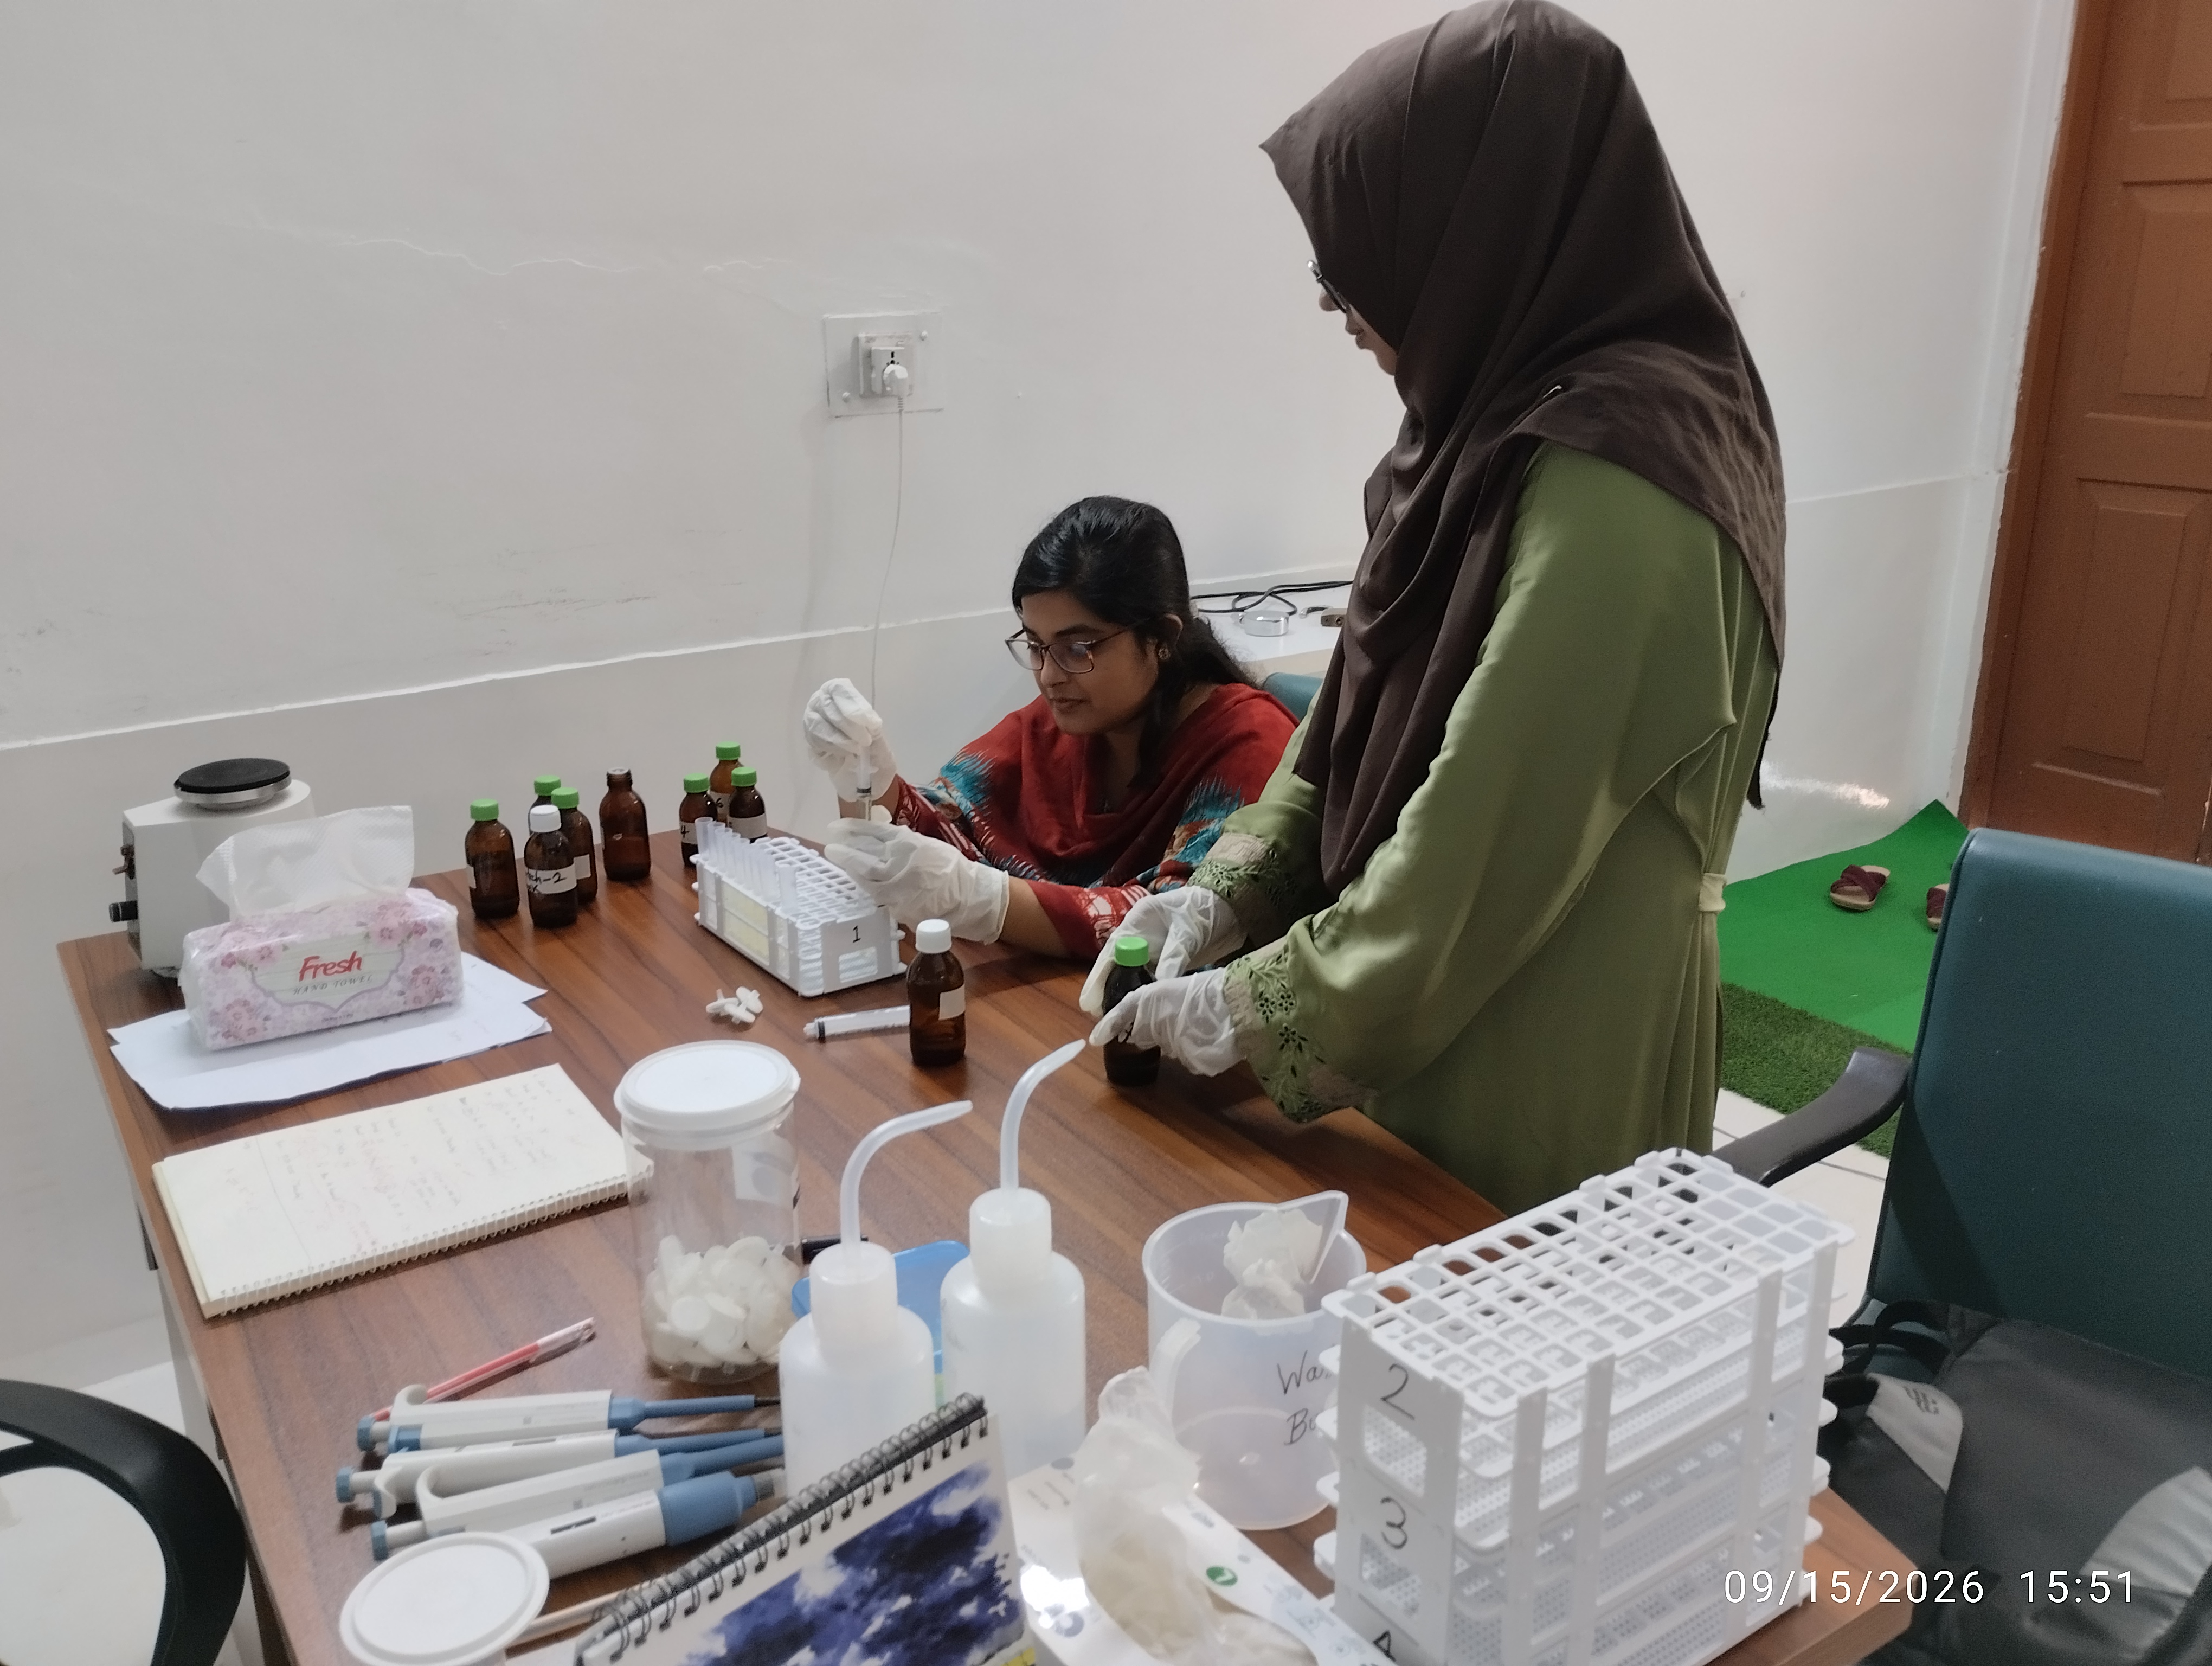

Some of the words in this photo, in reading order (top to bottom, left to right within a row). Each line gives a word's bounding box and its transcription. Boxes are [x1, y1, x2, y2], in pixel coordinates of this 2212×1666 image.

[716, 798, 724, 808] 6
[680, 825, 690, 838] 4
[852, 925, 861, 944] 1
[299, 950, 363, 982] Fresh
[293, 983, 328, 996] HAND
[332, 974, 373, 988] TOWEL
[1380, 1363, 1416, 1421] 2
[1380, 1496, 1408, 1551] 3
